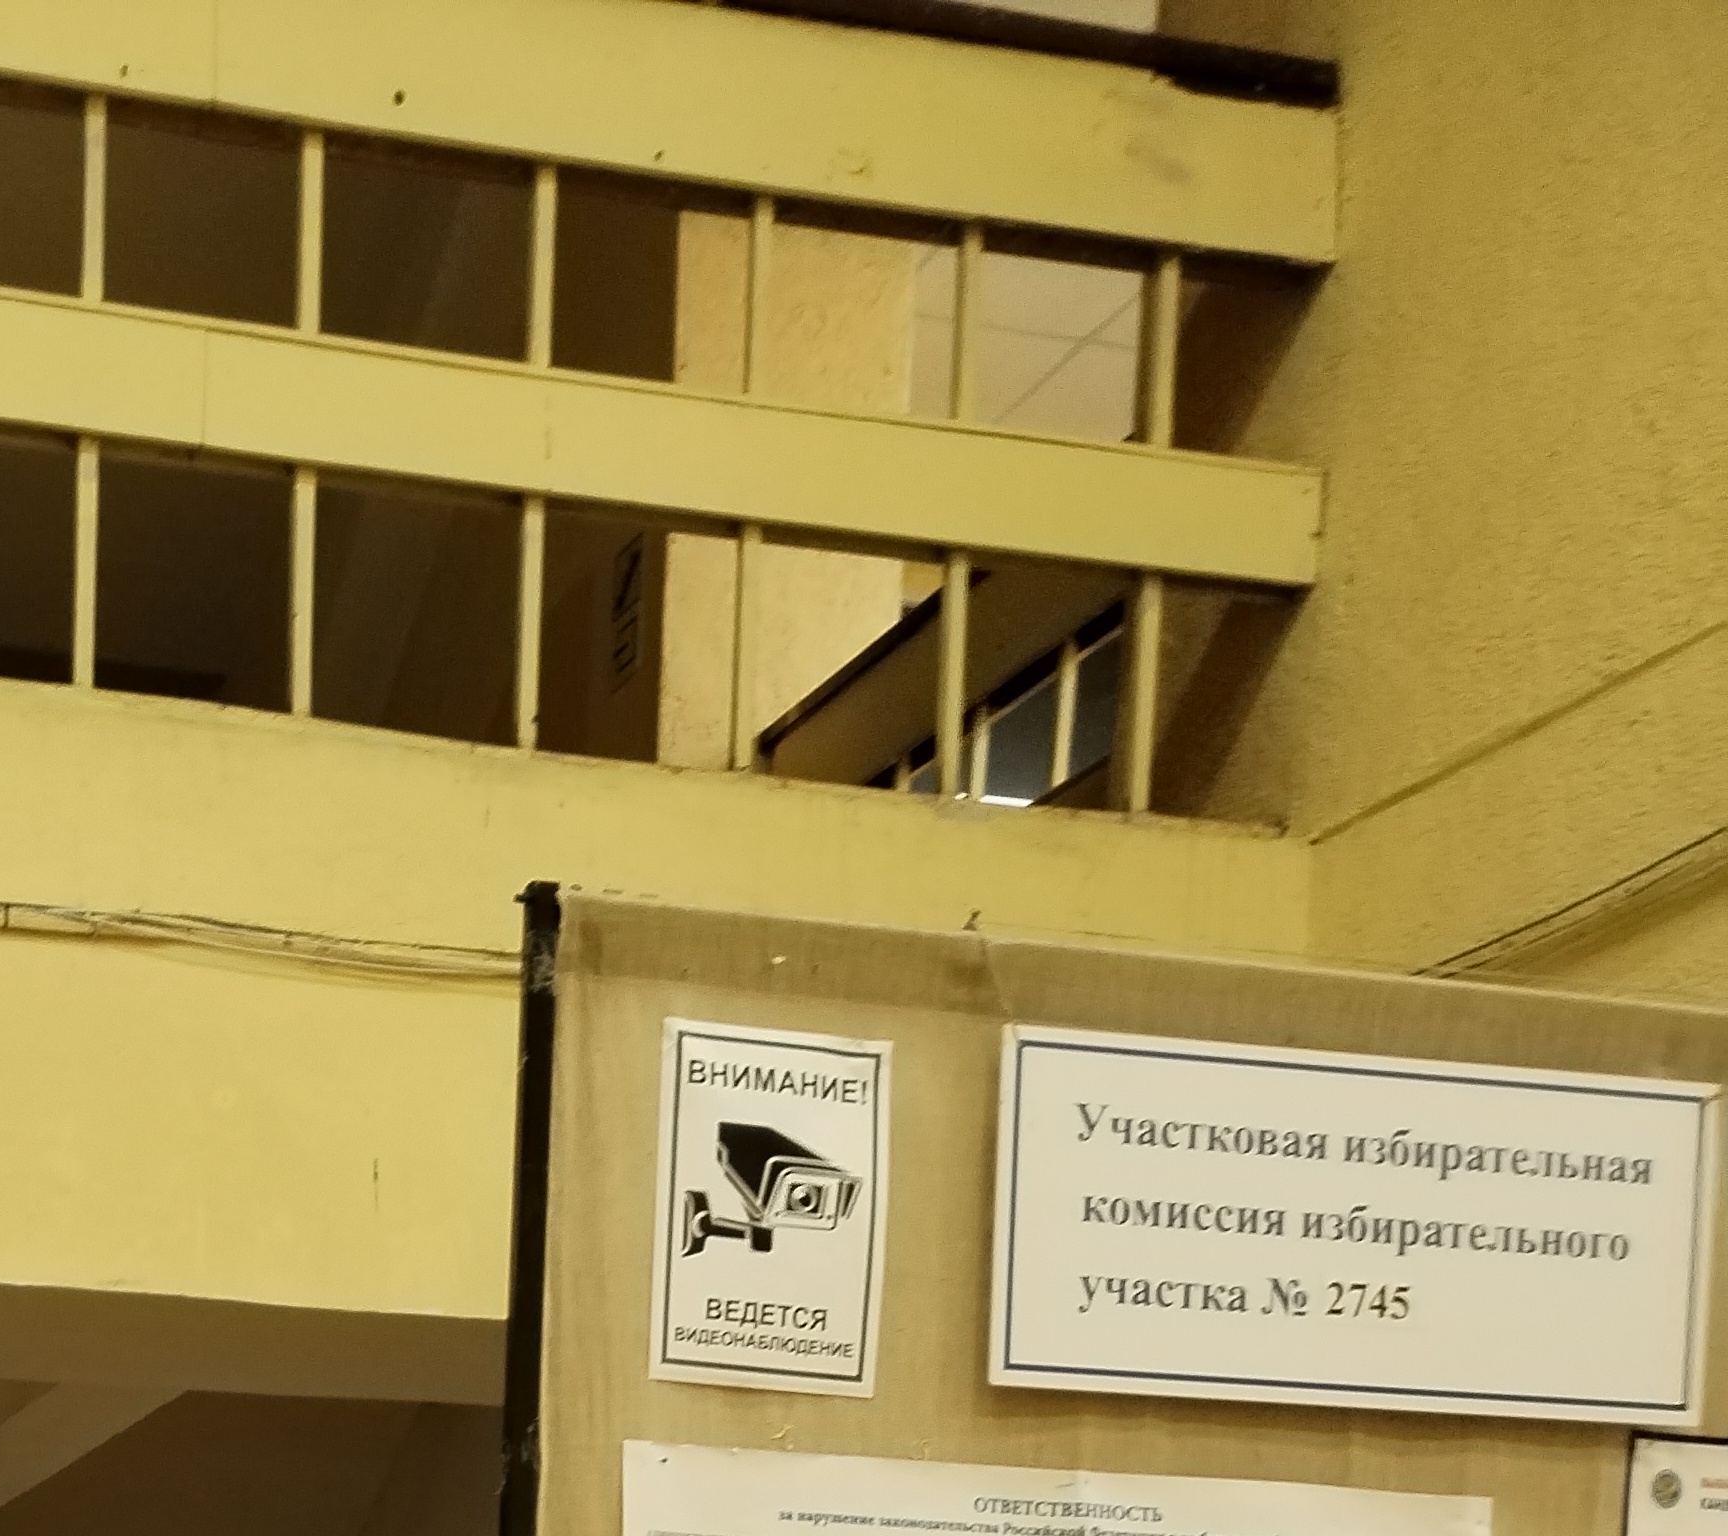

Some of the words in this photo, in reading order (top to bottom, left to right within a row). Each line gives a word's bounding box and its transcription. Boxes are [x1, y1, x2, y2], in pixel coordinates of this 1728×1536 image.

[687, 1058, 868, 1104] ВНИМАНИЕ!
[1074, 1102, 1329, 1161] Участковая
[1342, 1128, 1654, 1185] избирательная
[1081, 1195, 1287, 1237] комиссия
[1300, 1204, 1630, 1261] избирательного
[705, 1297, 829, 1332] ВЕДЕТСЯ
[1078, 1274, 1249, 1314] участка
[1260, 1277, 1308, 1317] №
[1325, 1280, 1412, 1319] 2745
[674, 1326, 855, 1359] ВИДЕОНАБЛЮДЕНИЕ
[797, 1512, 875, 1527] нарушение
[974, 1496, 1163, 1522] ОТВЕТСТВЕННОСТЬ
